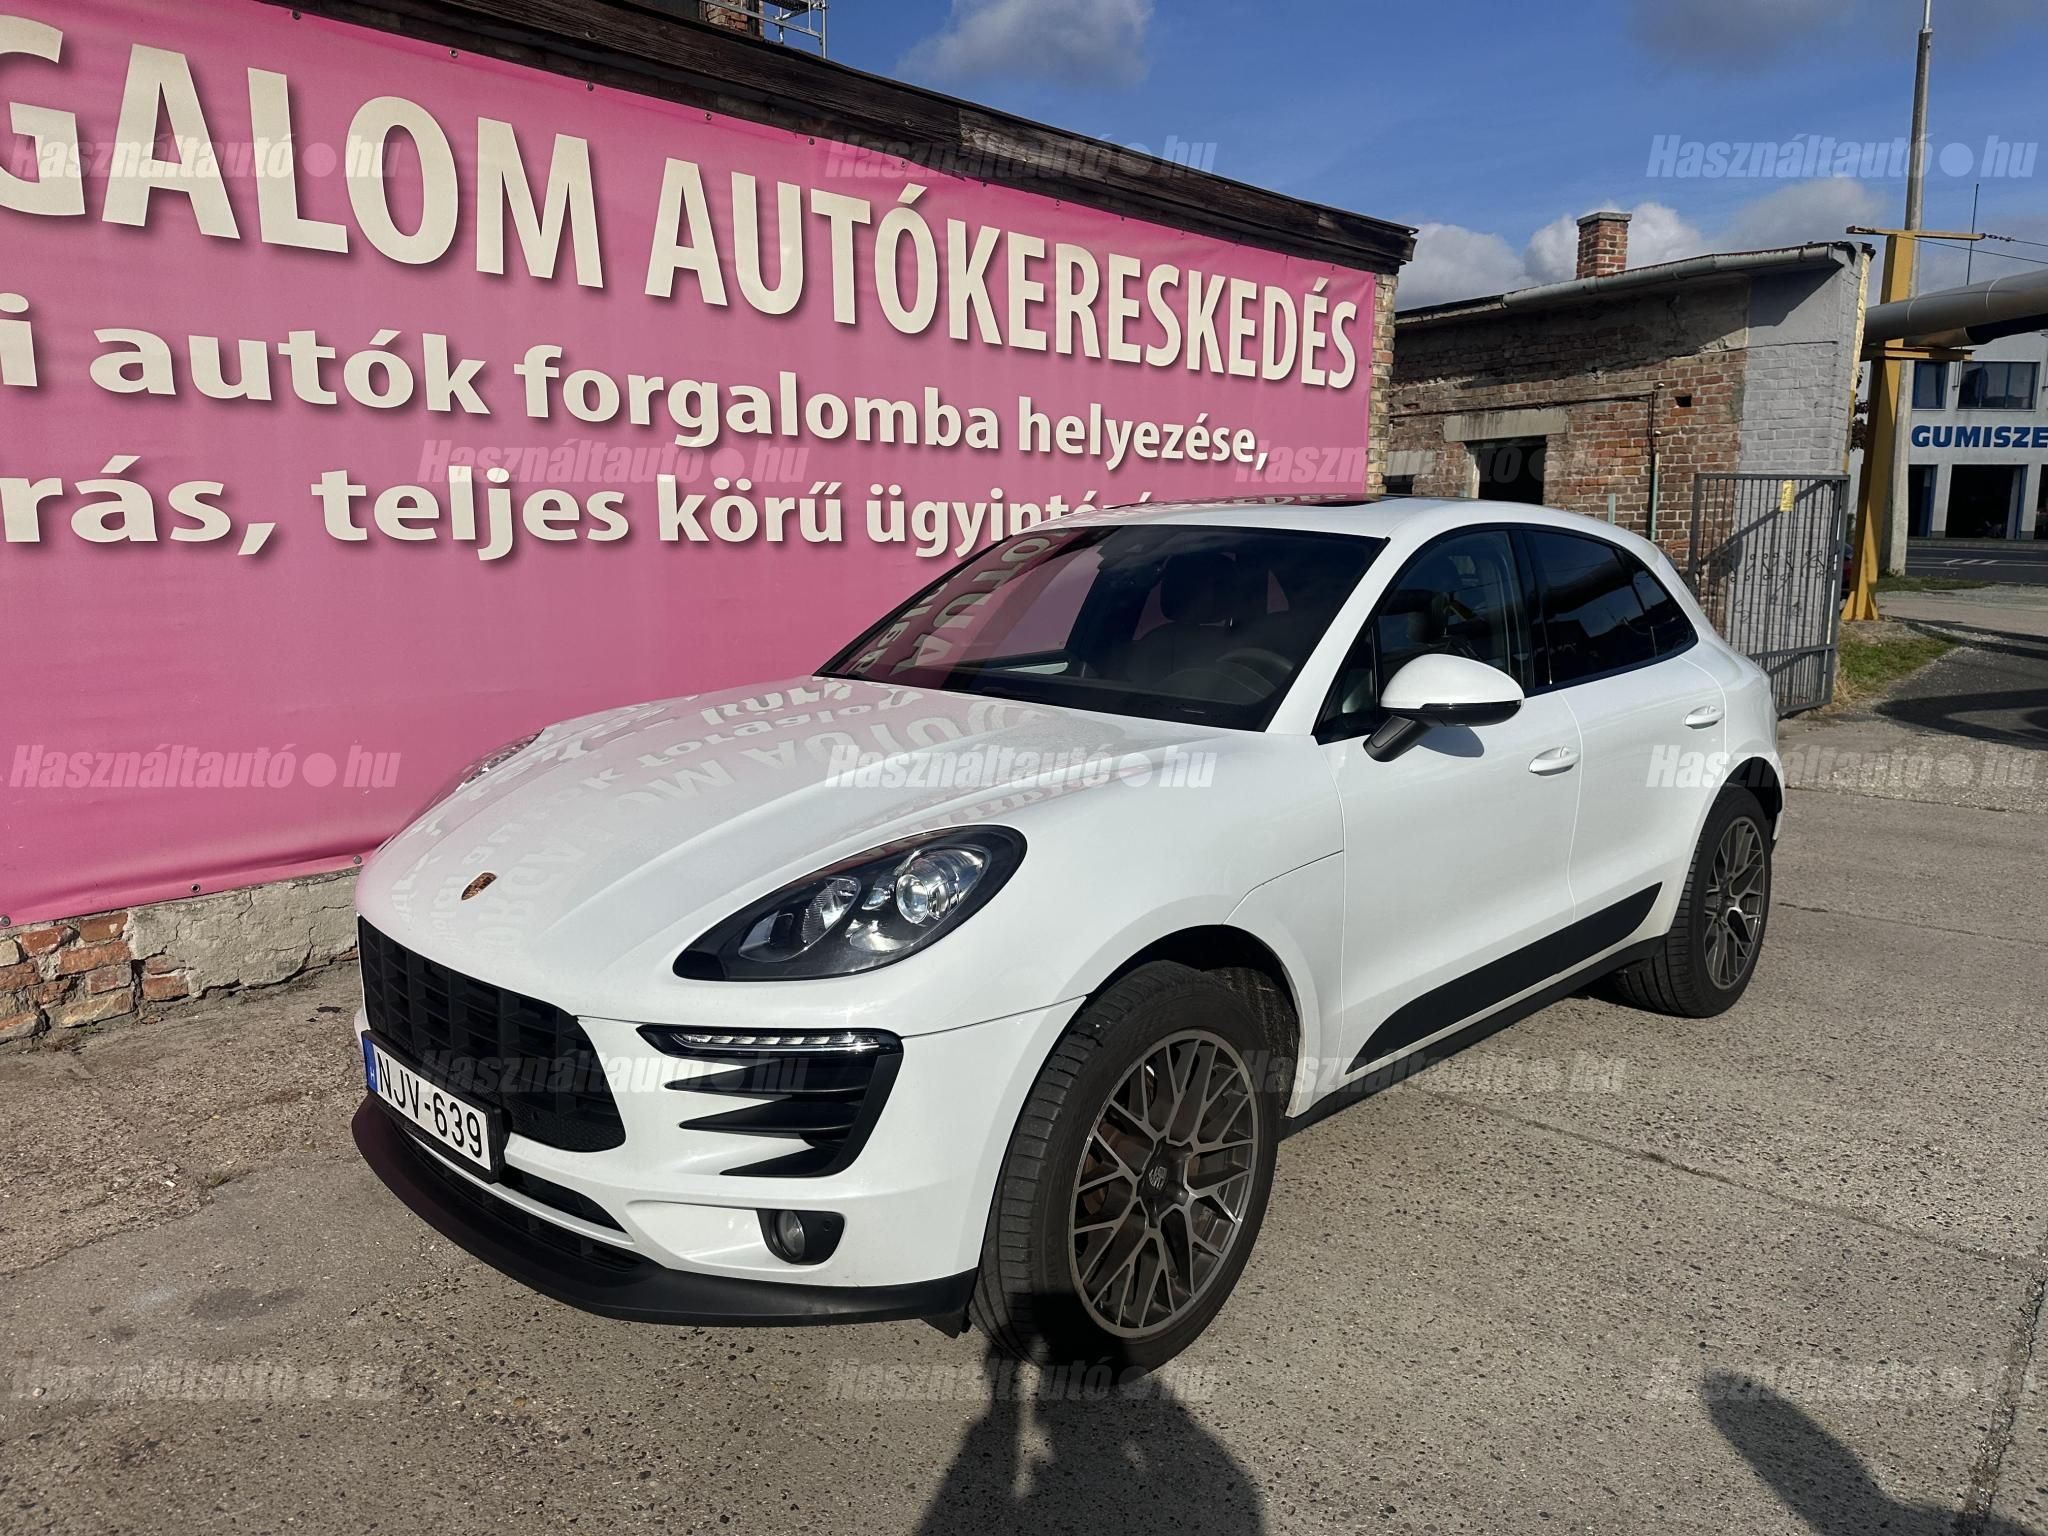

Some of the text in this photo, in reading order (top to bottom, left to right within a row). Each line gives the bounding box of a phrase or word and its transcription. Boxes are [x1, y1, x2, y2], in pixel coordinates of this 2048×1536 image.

[645, 157, 1358, 390] AUTÓKERESKEDÉS
[90, 328, 491, 415] autók
[514, 344, 999, 449] forgalomba
[1019, 396, 1268, 470] helyezése,
[1911, 425, 2048, 448] GUMISZE
[0, 455, 276, 556] rás,
[310, 465, 630, 561] teljes
[657, 474, 843, 544] körű
[377, 1052, 483, 1159] NJV-639
